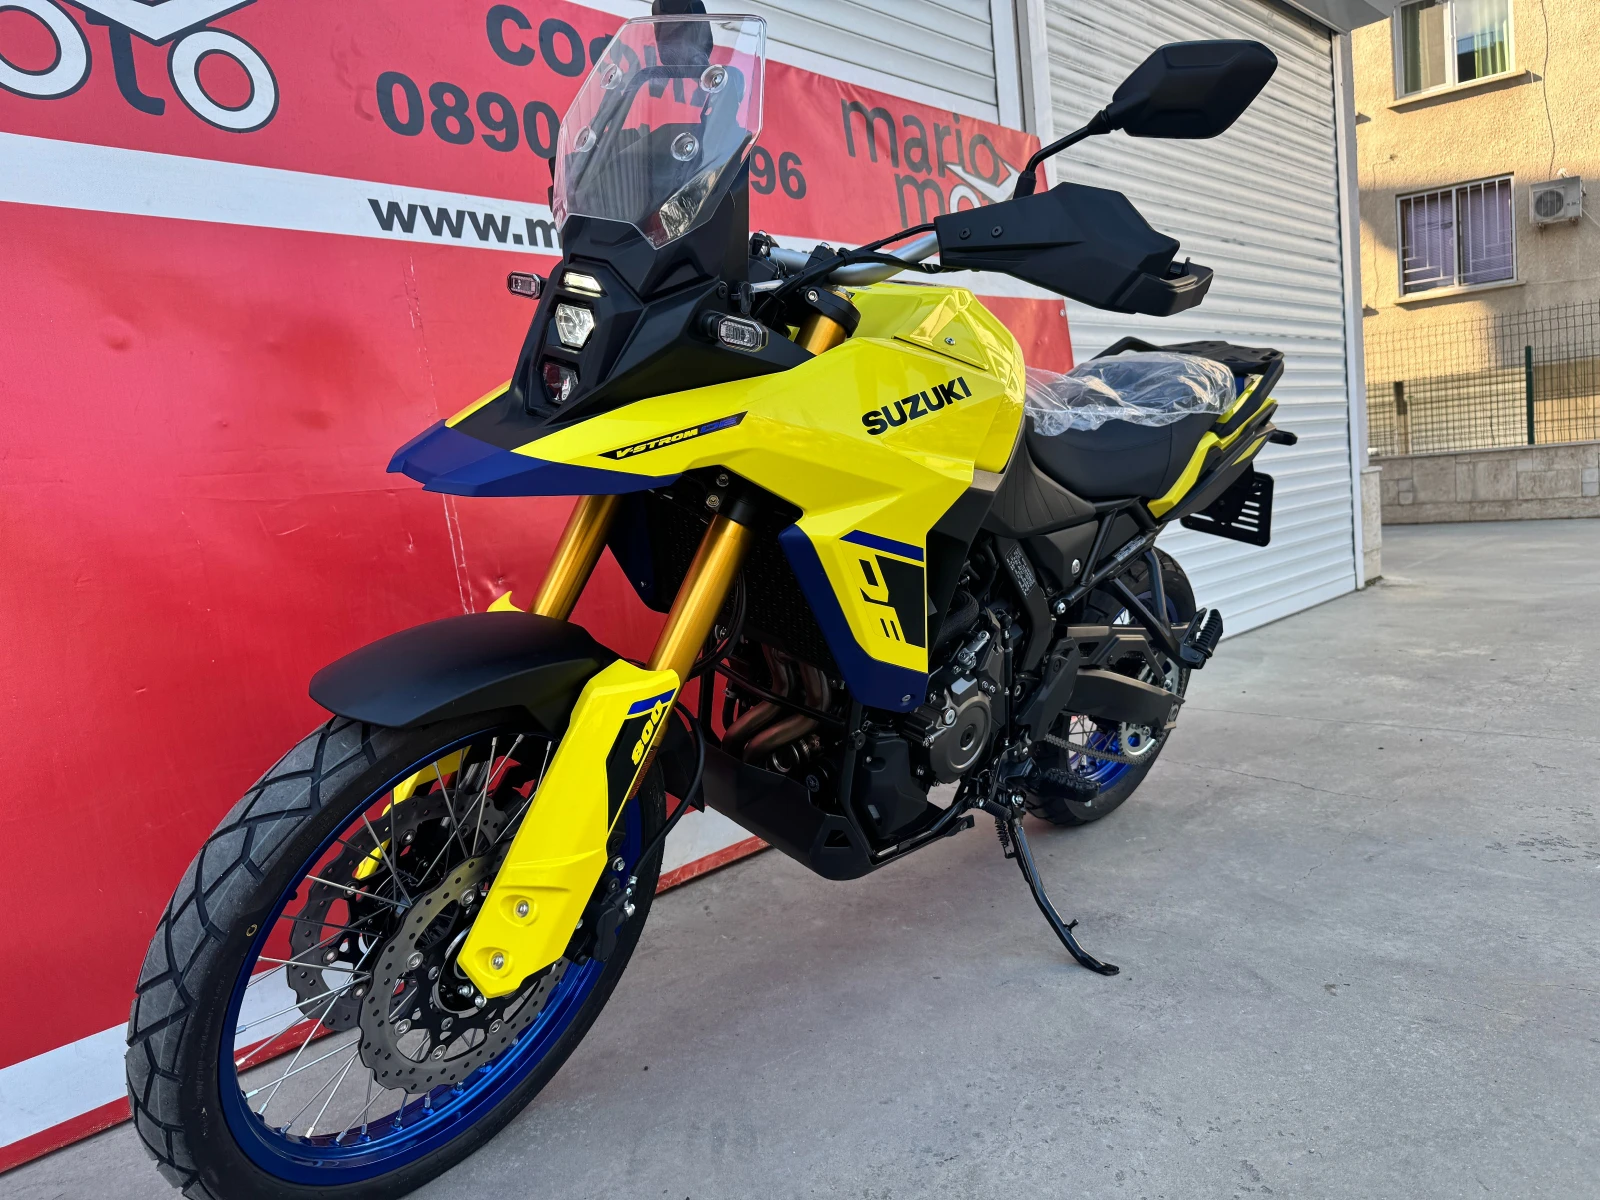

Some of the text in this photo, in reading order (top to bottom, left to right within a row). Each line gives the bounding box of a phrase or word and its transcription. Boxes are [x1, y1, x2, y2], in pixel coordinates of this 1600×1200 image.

[376, 71, 562, 160] 0890
[841, 98, 999, 187] mario
[862, 376, 972, 435] SUZUKI
[616, 428, 699, 459] V-STROM
[631, 699, 664, 766] 800
